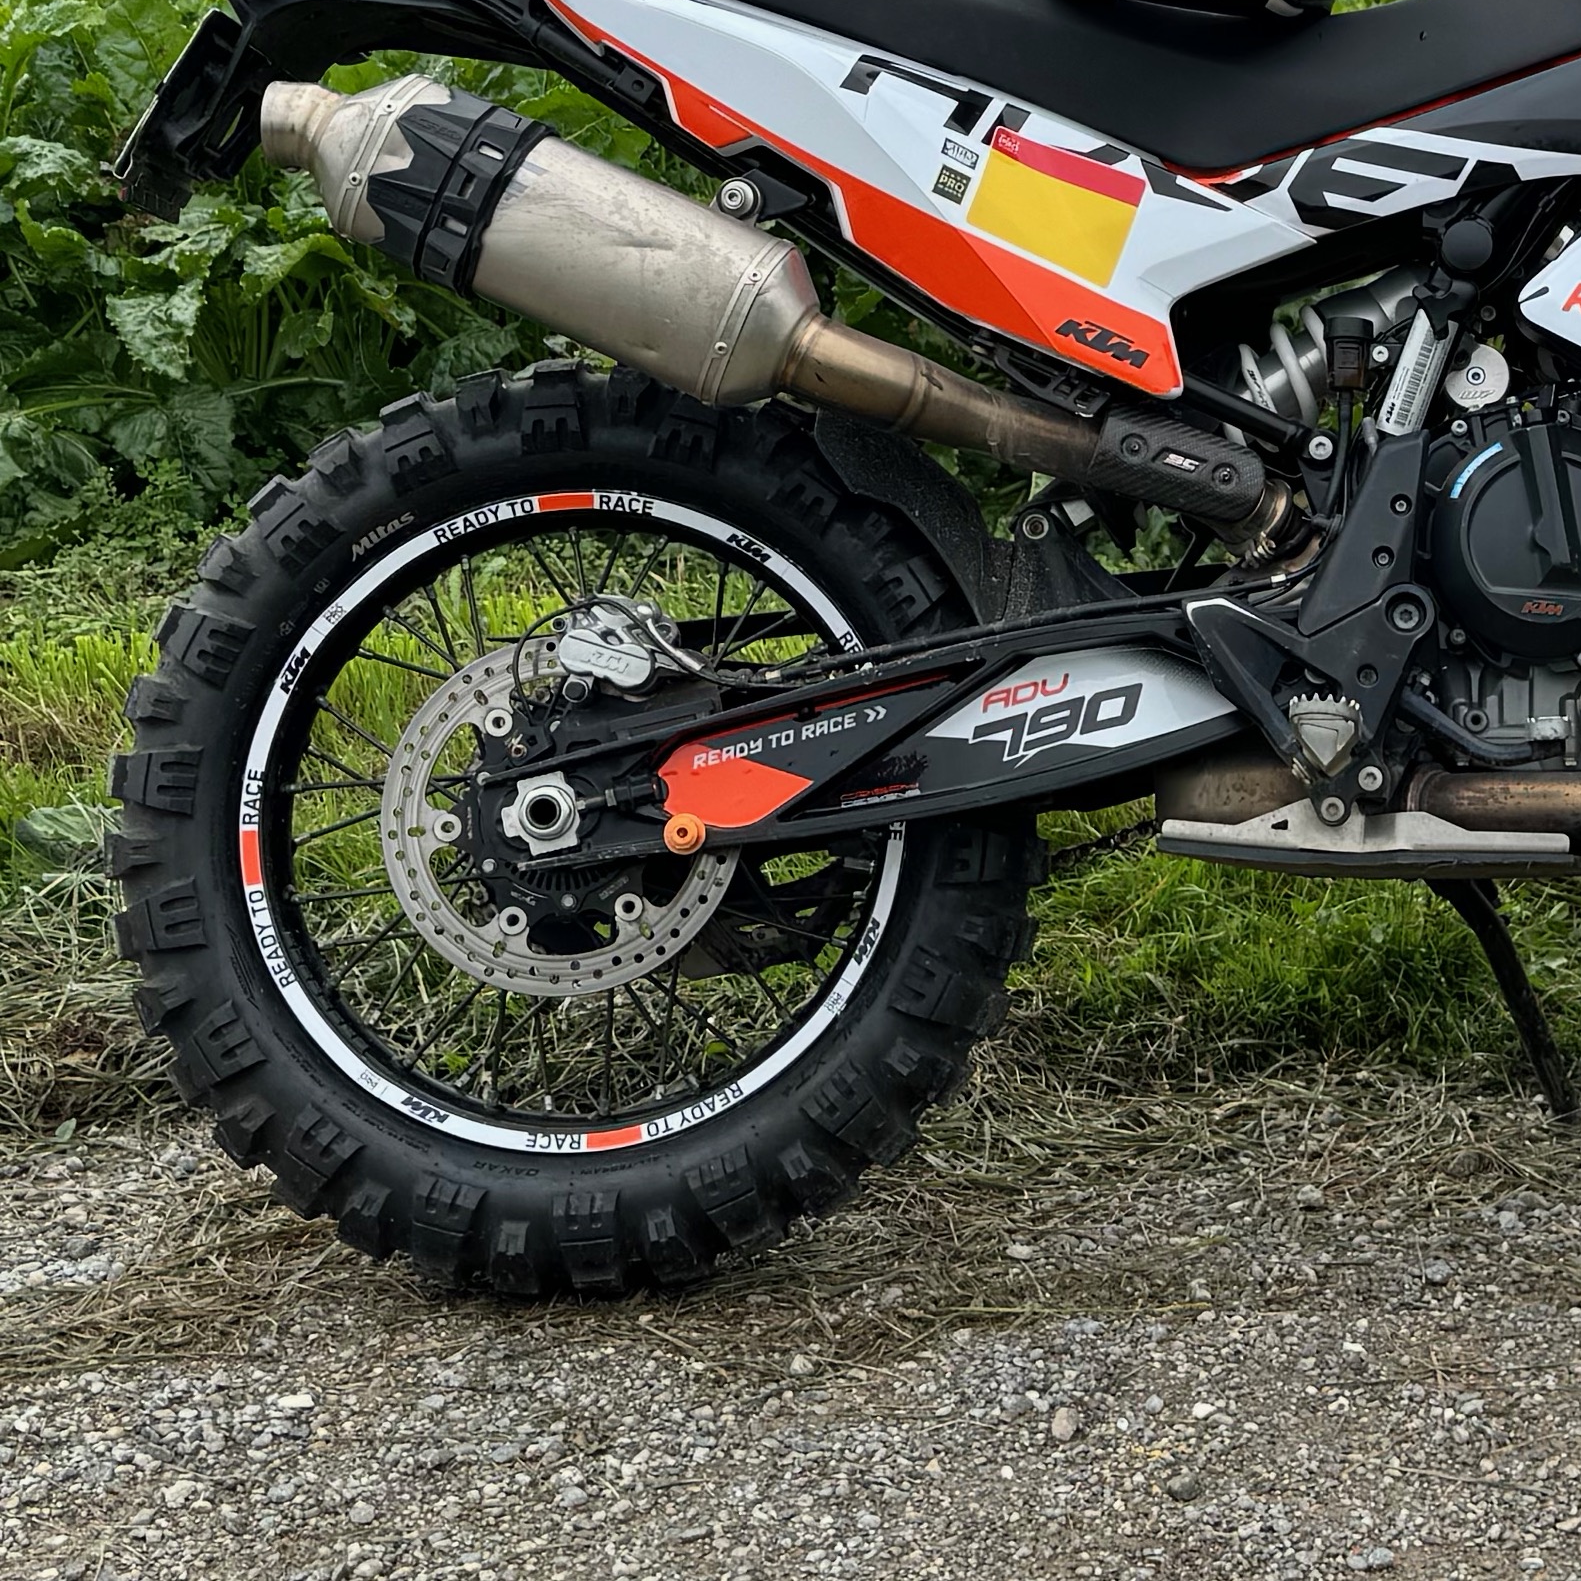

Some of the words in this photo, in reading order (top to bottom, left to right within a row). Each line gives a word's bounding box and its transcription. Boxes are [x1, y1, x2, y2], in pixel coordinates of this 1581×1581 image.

[1055, 319, 1150, 369] KTM
[351, 510, 416, 562] Mitas
[432, 504, 502, 545] READY
[506, 498, 536, 516] TO
[599, 493, 655, 515] RACE
[726, 533, 772, 564] KTM
[1520, 598, 1565, 617] KTM
[279, 645, 312, 695] KTM
[980, 672, 1071, 714] ADV
[691, 737, 764, 771] READY
[768, 727, 795, 751] TO
[800, 711, 858, 740] RACE
[969, 682, 1145, 763] 790
[241, 768, 265, 826] RACE
[248, 889, 268, 917] TO
[254, 921, 298, 989] READY
[852, 916, 881, 966] KTM
[400, 1094, 450, 1125] KTM
[680, 1079, 745, 1127] READY
[525, 1132, 582, 1151] RACE
[645, 1120, 676, 1138] TO
[471, 1159, 540, 1177] DAKAR
